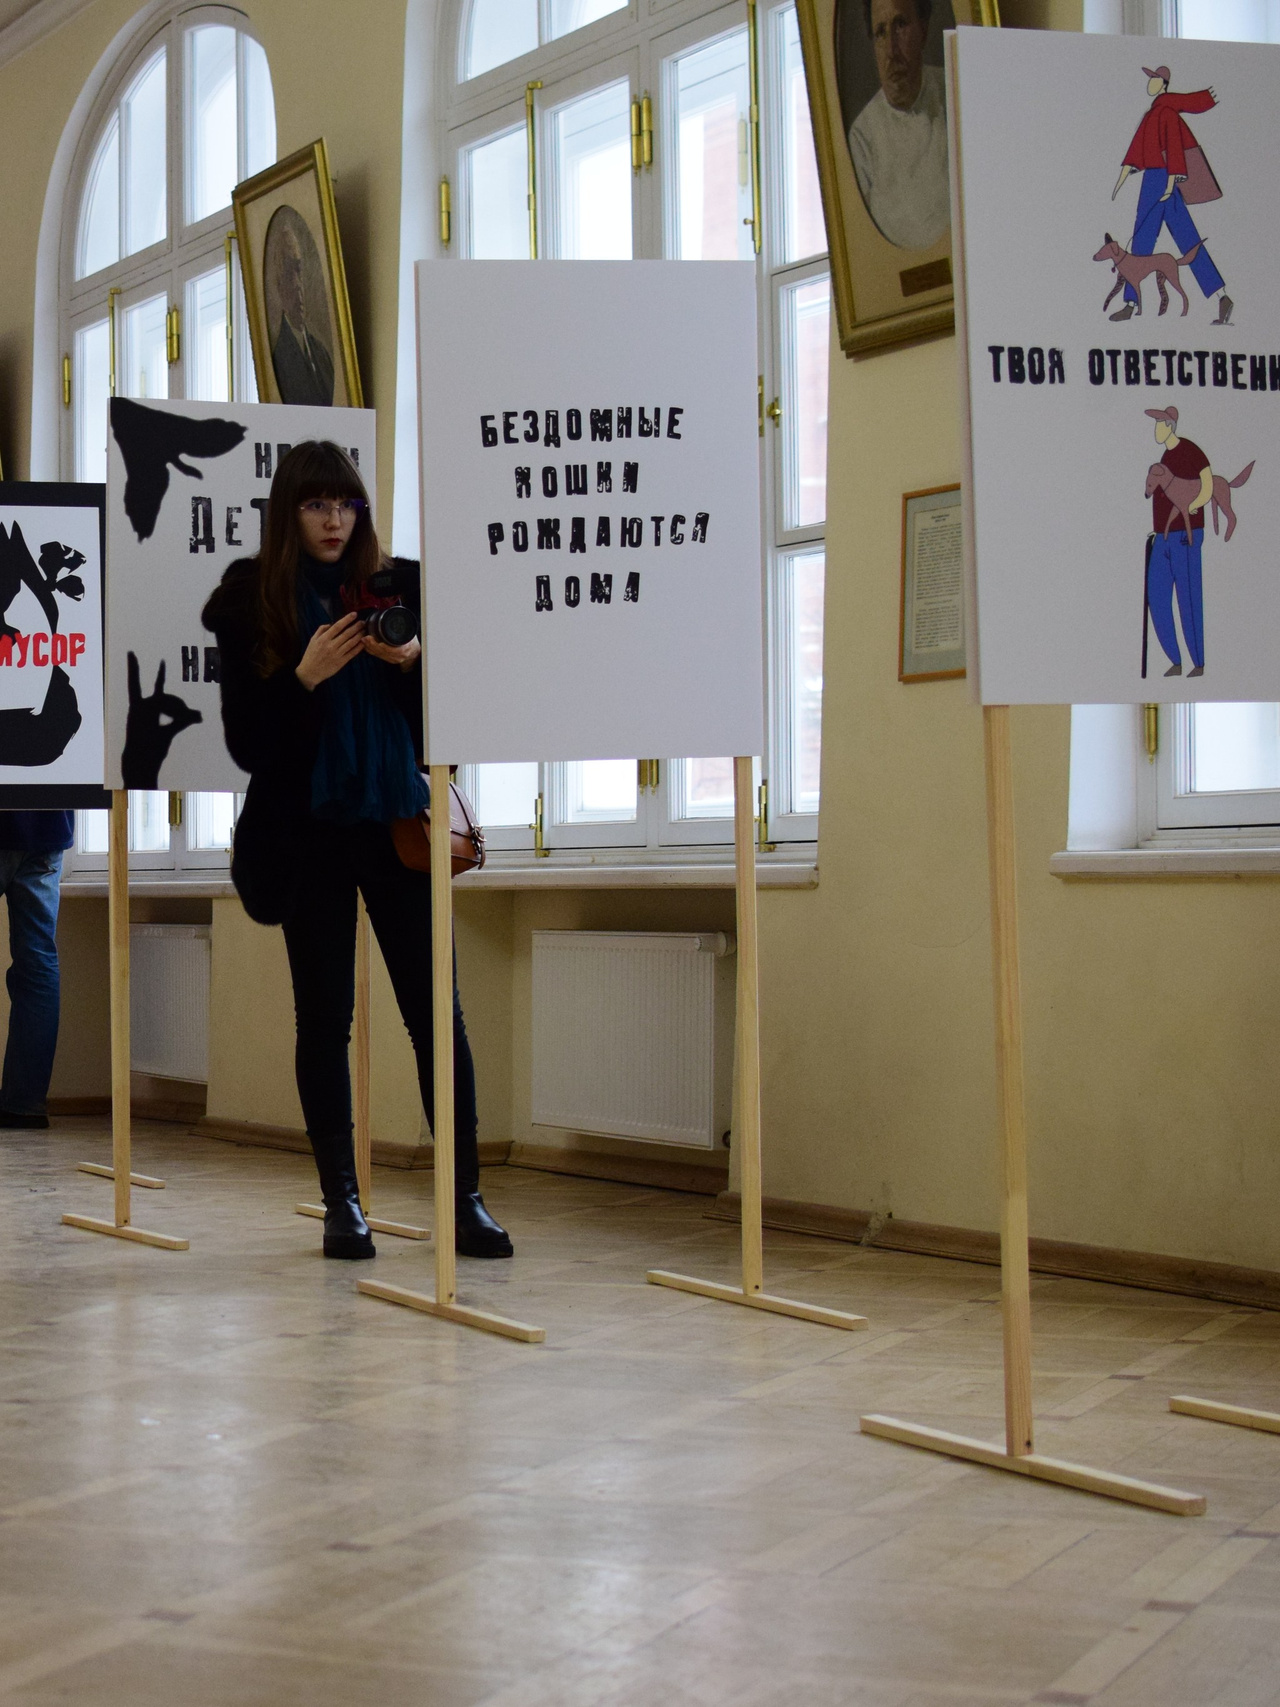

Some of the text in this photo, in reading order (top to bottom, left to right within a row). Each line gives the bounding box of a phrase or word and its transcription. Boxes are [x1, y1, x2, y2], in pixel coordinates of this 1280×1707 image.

[987, 345, 1280, 391] ТВОЯ ОТВЕТСТВЕНН
[480, 406, 684, 448] БЕЗДОМНЫЕ
[514, 461, 639, 499] КОШКИ
[487, 512, 710, 555] РОЖДАЮТСЯ
[535, 571, 640, 612] ДОМА
